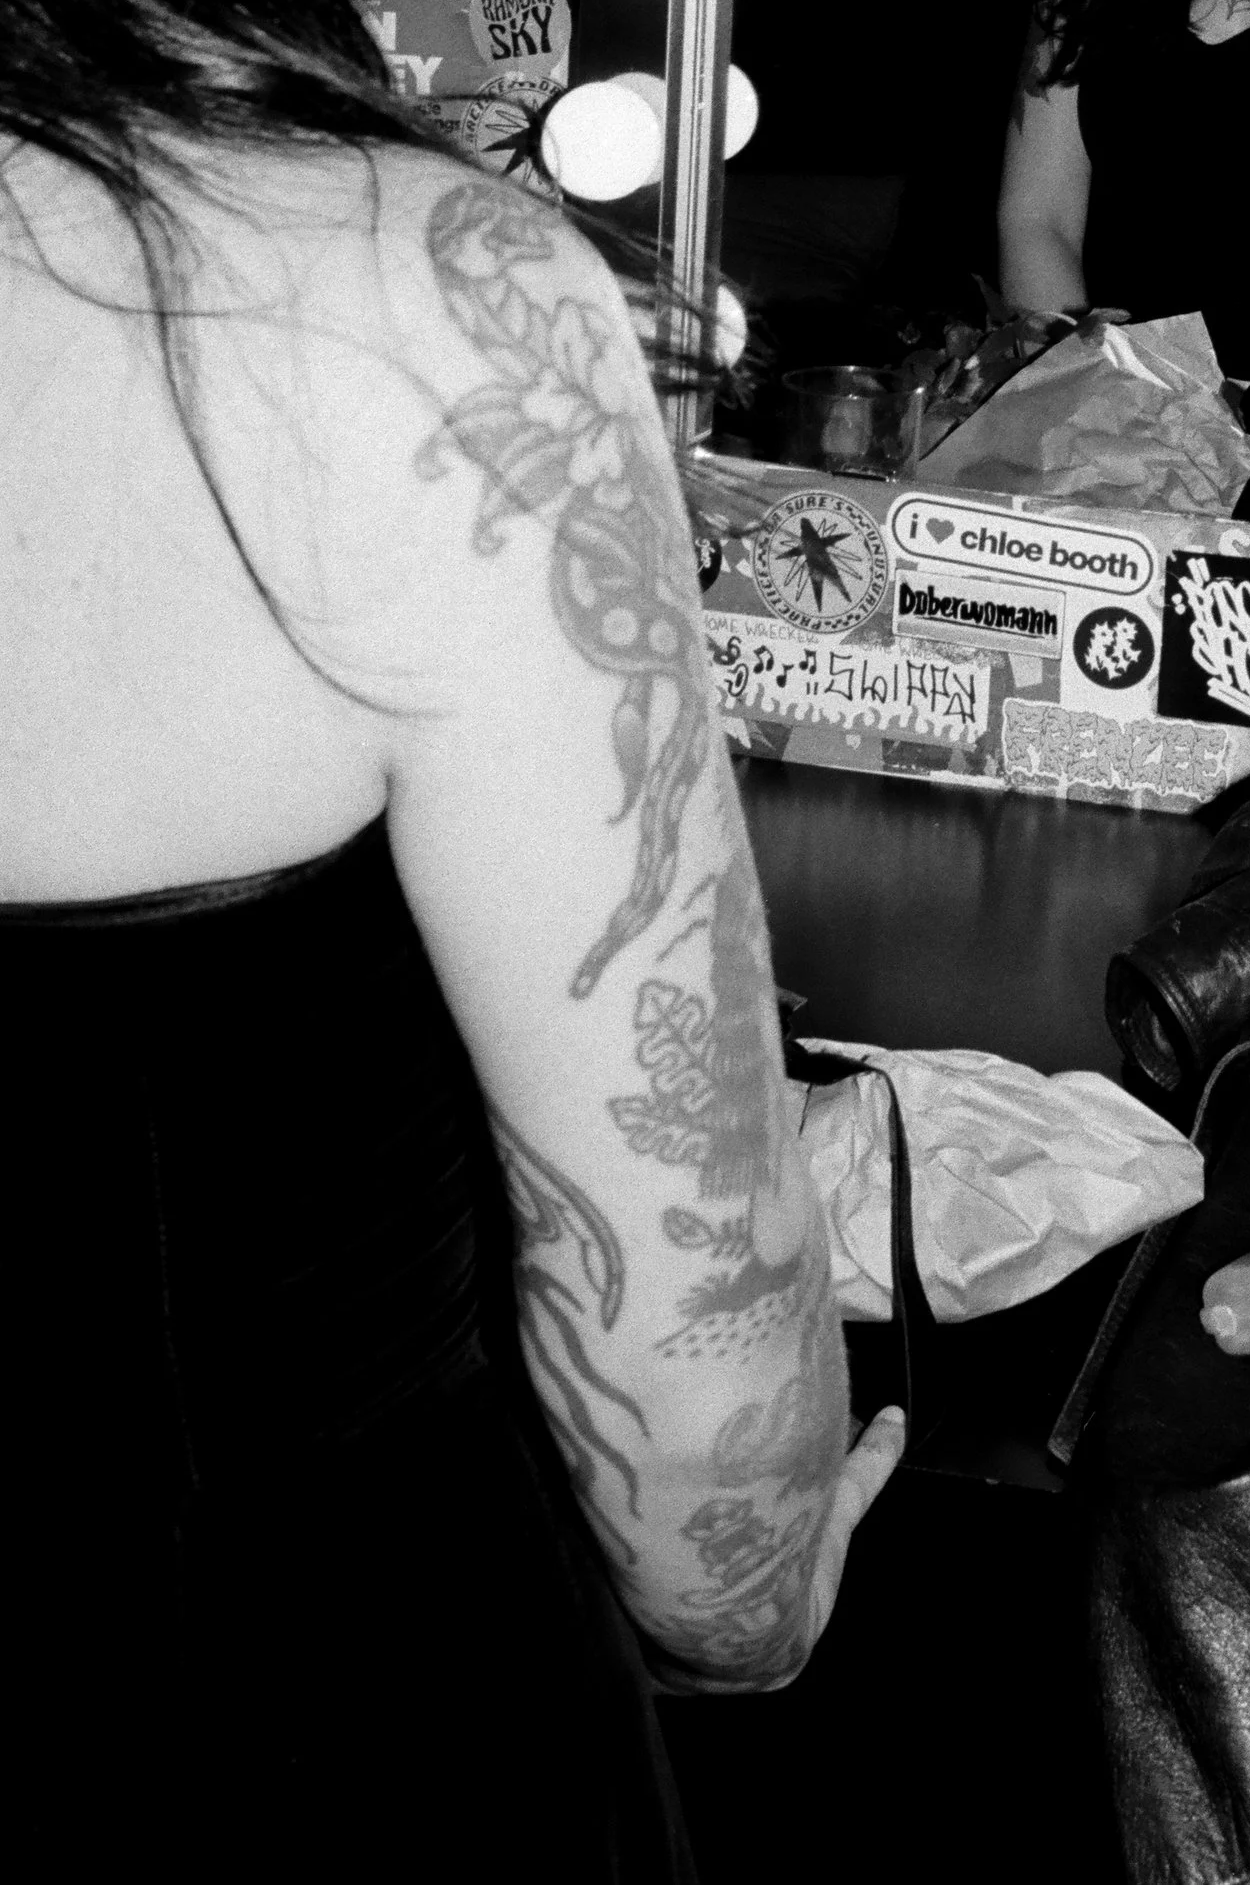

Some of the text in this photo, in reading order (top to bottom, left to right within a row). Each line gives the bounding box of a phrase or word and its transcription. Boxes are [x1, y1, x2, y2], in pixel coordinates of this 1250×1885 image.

[488, 4, 553, 62] SKY
[757, 495, 886, 631] SURE'S UNUSUAL PRACTICE
[908, 512, 1139, 581] i chloe booth
